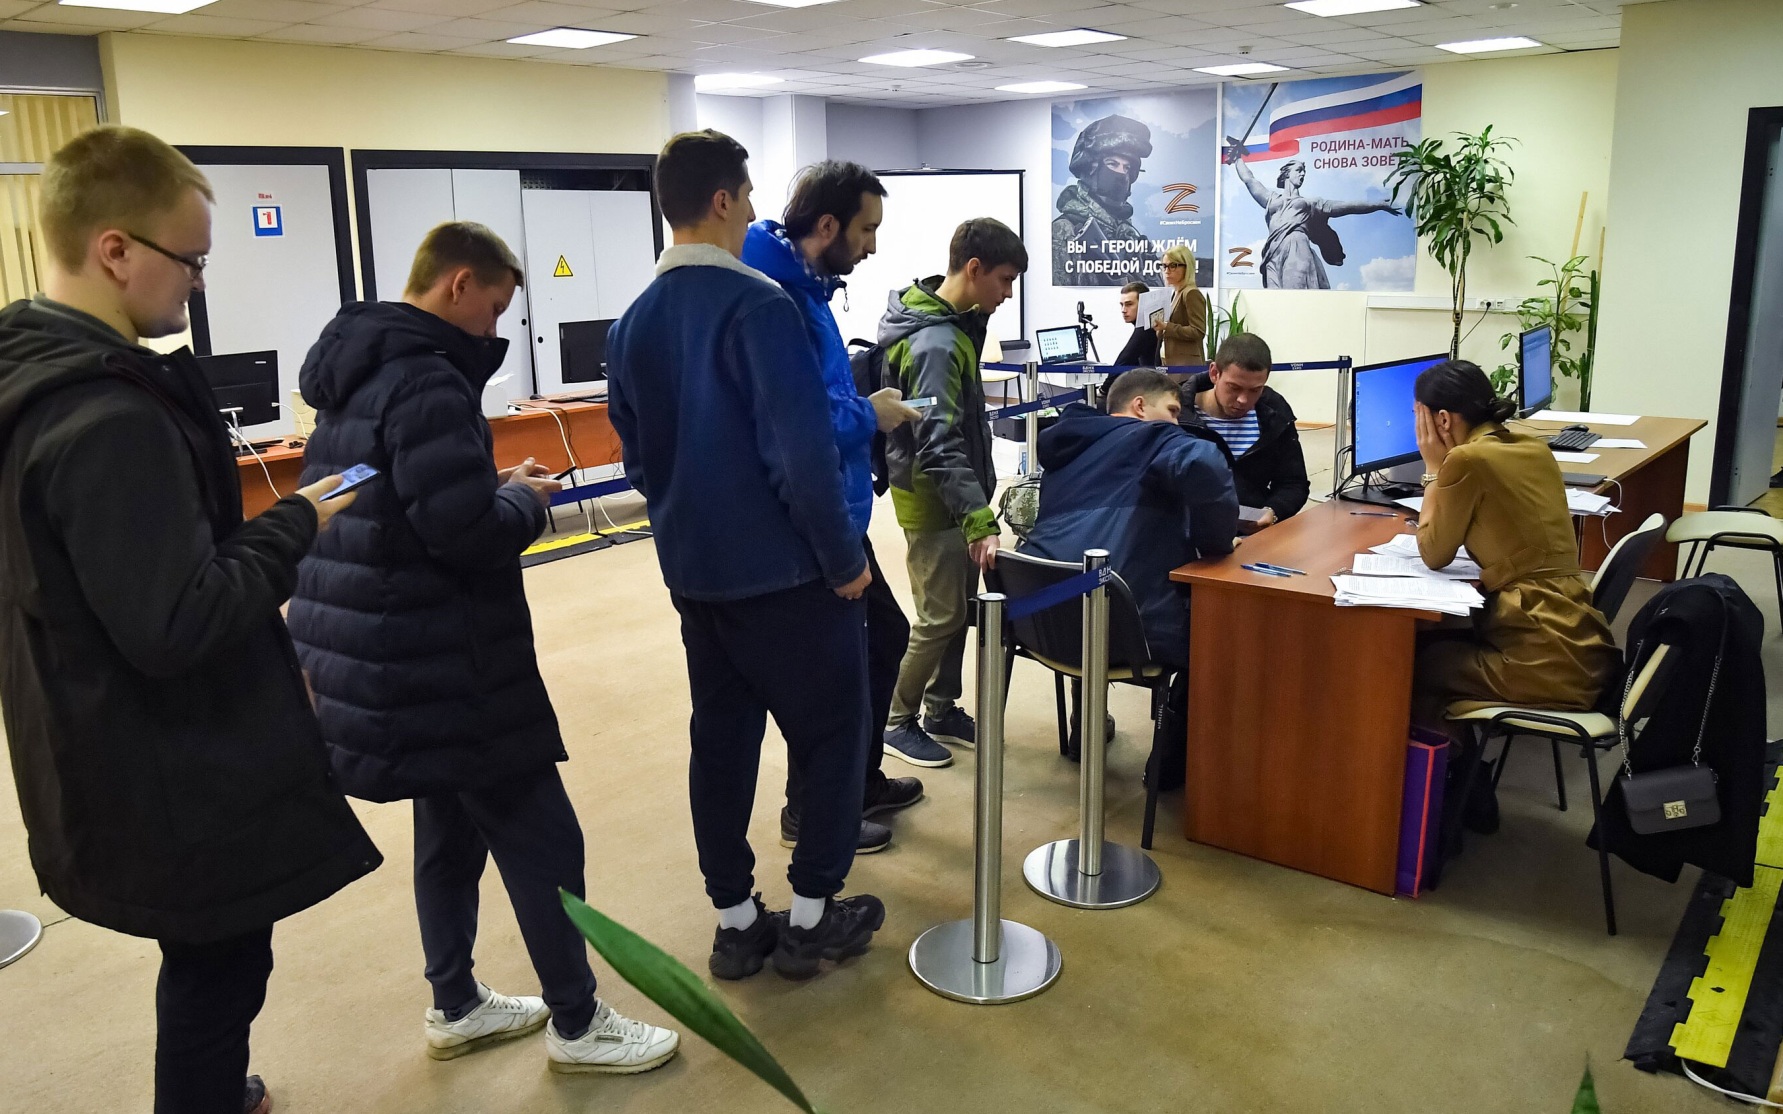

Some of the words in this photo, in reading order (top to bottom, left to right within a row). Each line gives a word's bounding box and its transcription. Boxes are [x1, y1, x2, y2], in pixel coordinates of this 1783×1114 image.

[1311, 137, 1409, 154] РОДИНА-МАТЬ
[1314, 157, 1357, 169] СНОВА
[1067, 240, 1086, 253] ВЫ
[1101, 240, 1148, 253] ГЕРОИ!
[1065, 260, 1074, 273] С
[1076, 257, 1140, 276] ПОБЕДОЙ
